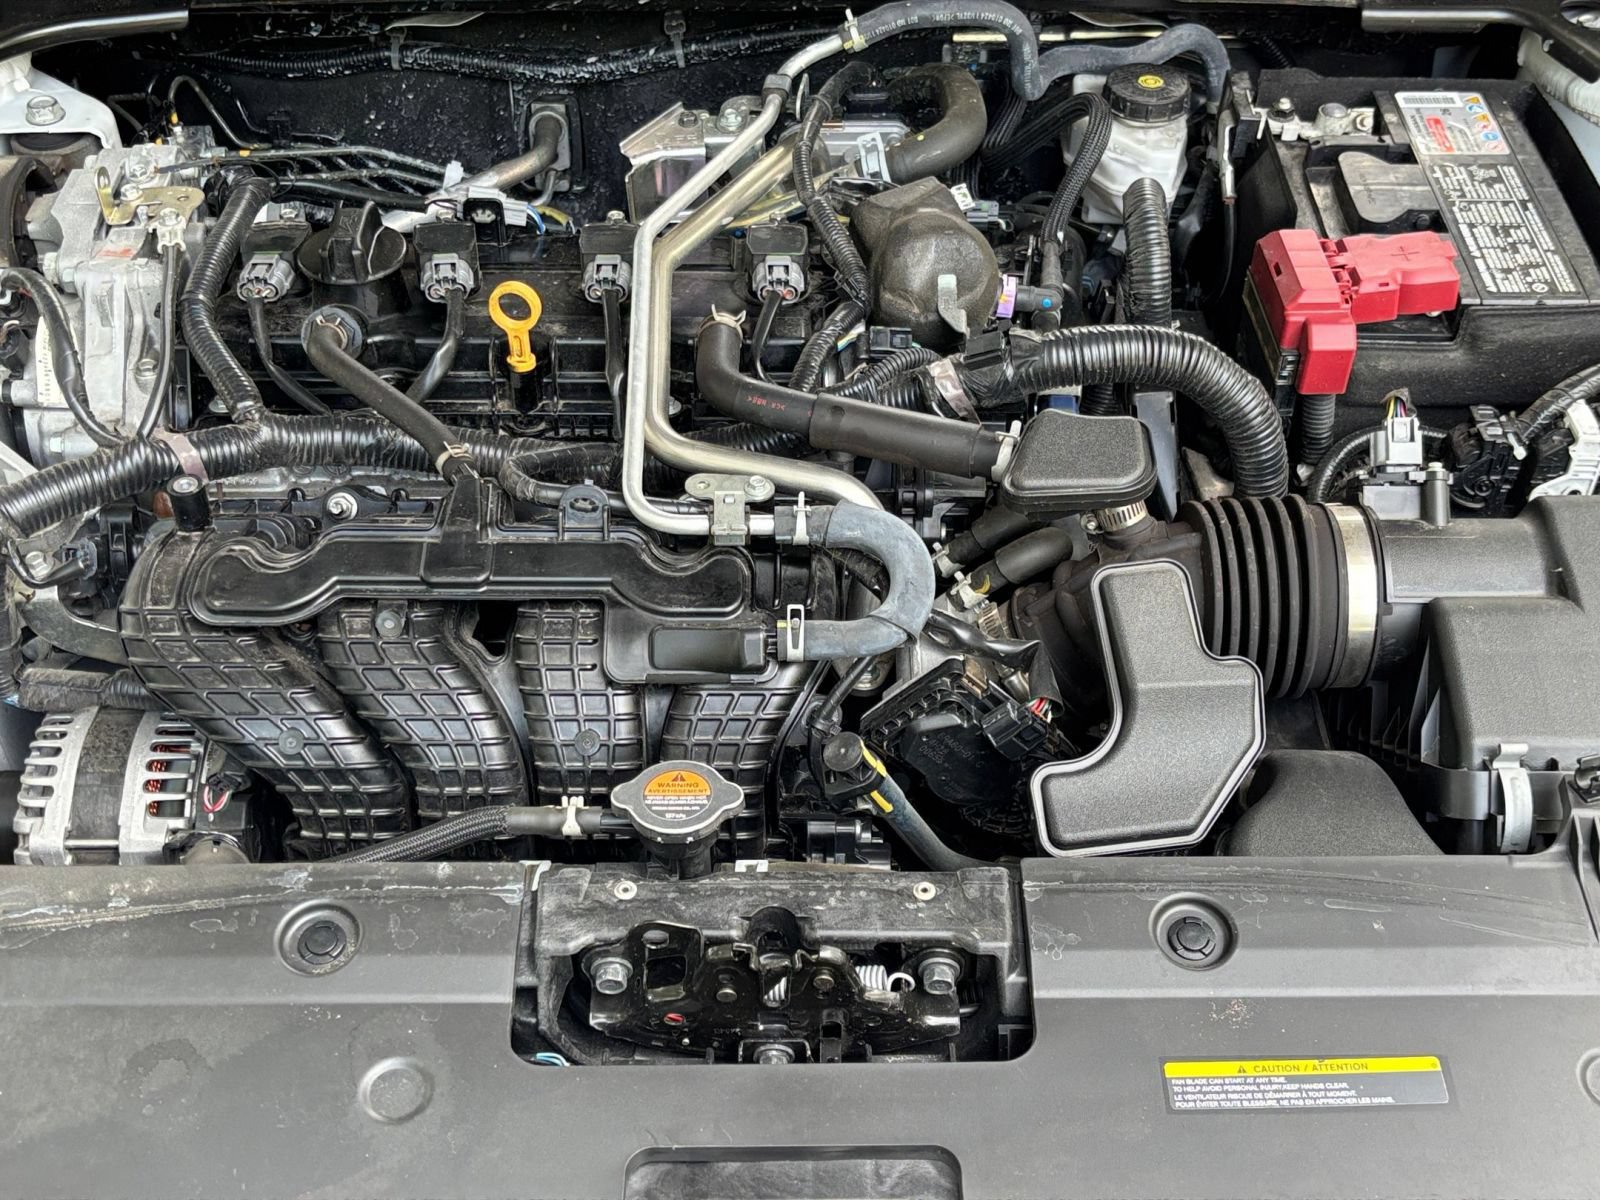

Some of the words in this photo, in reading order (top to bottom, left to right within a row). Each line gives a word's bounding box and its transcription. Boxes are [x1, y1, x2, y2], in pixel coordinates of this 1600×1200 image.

[1253, 1064, 1300, 1074] CAUTION
[1303, 1064, 1308, 1072] /
[1312, 1062, 1368, 1072] ATTENTION
[1208, 1077, 1224, 1085] CAN
[1219, 1100, 1241, 1108] TOUTE
